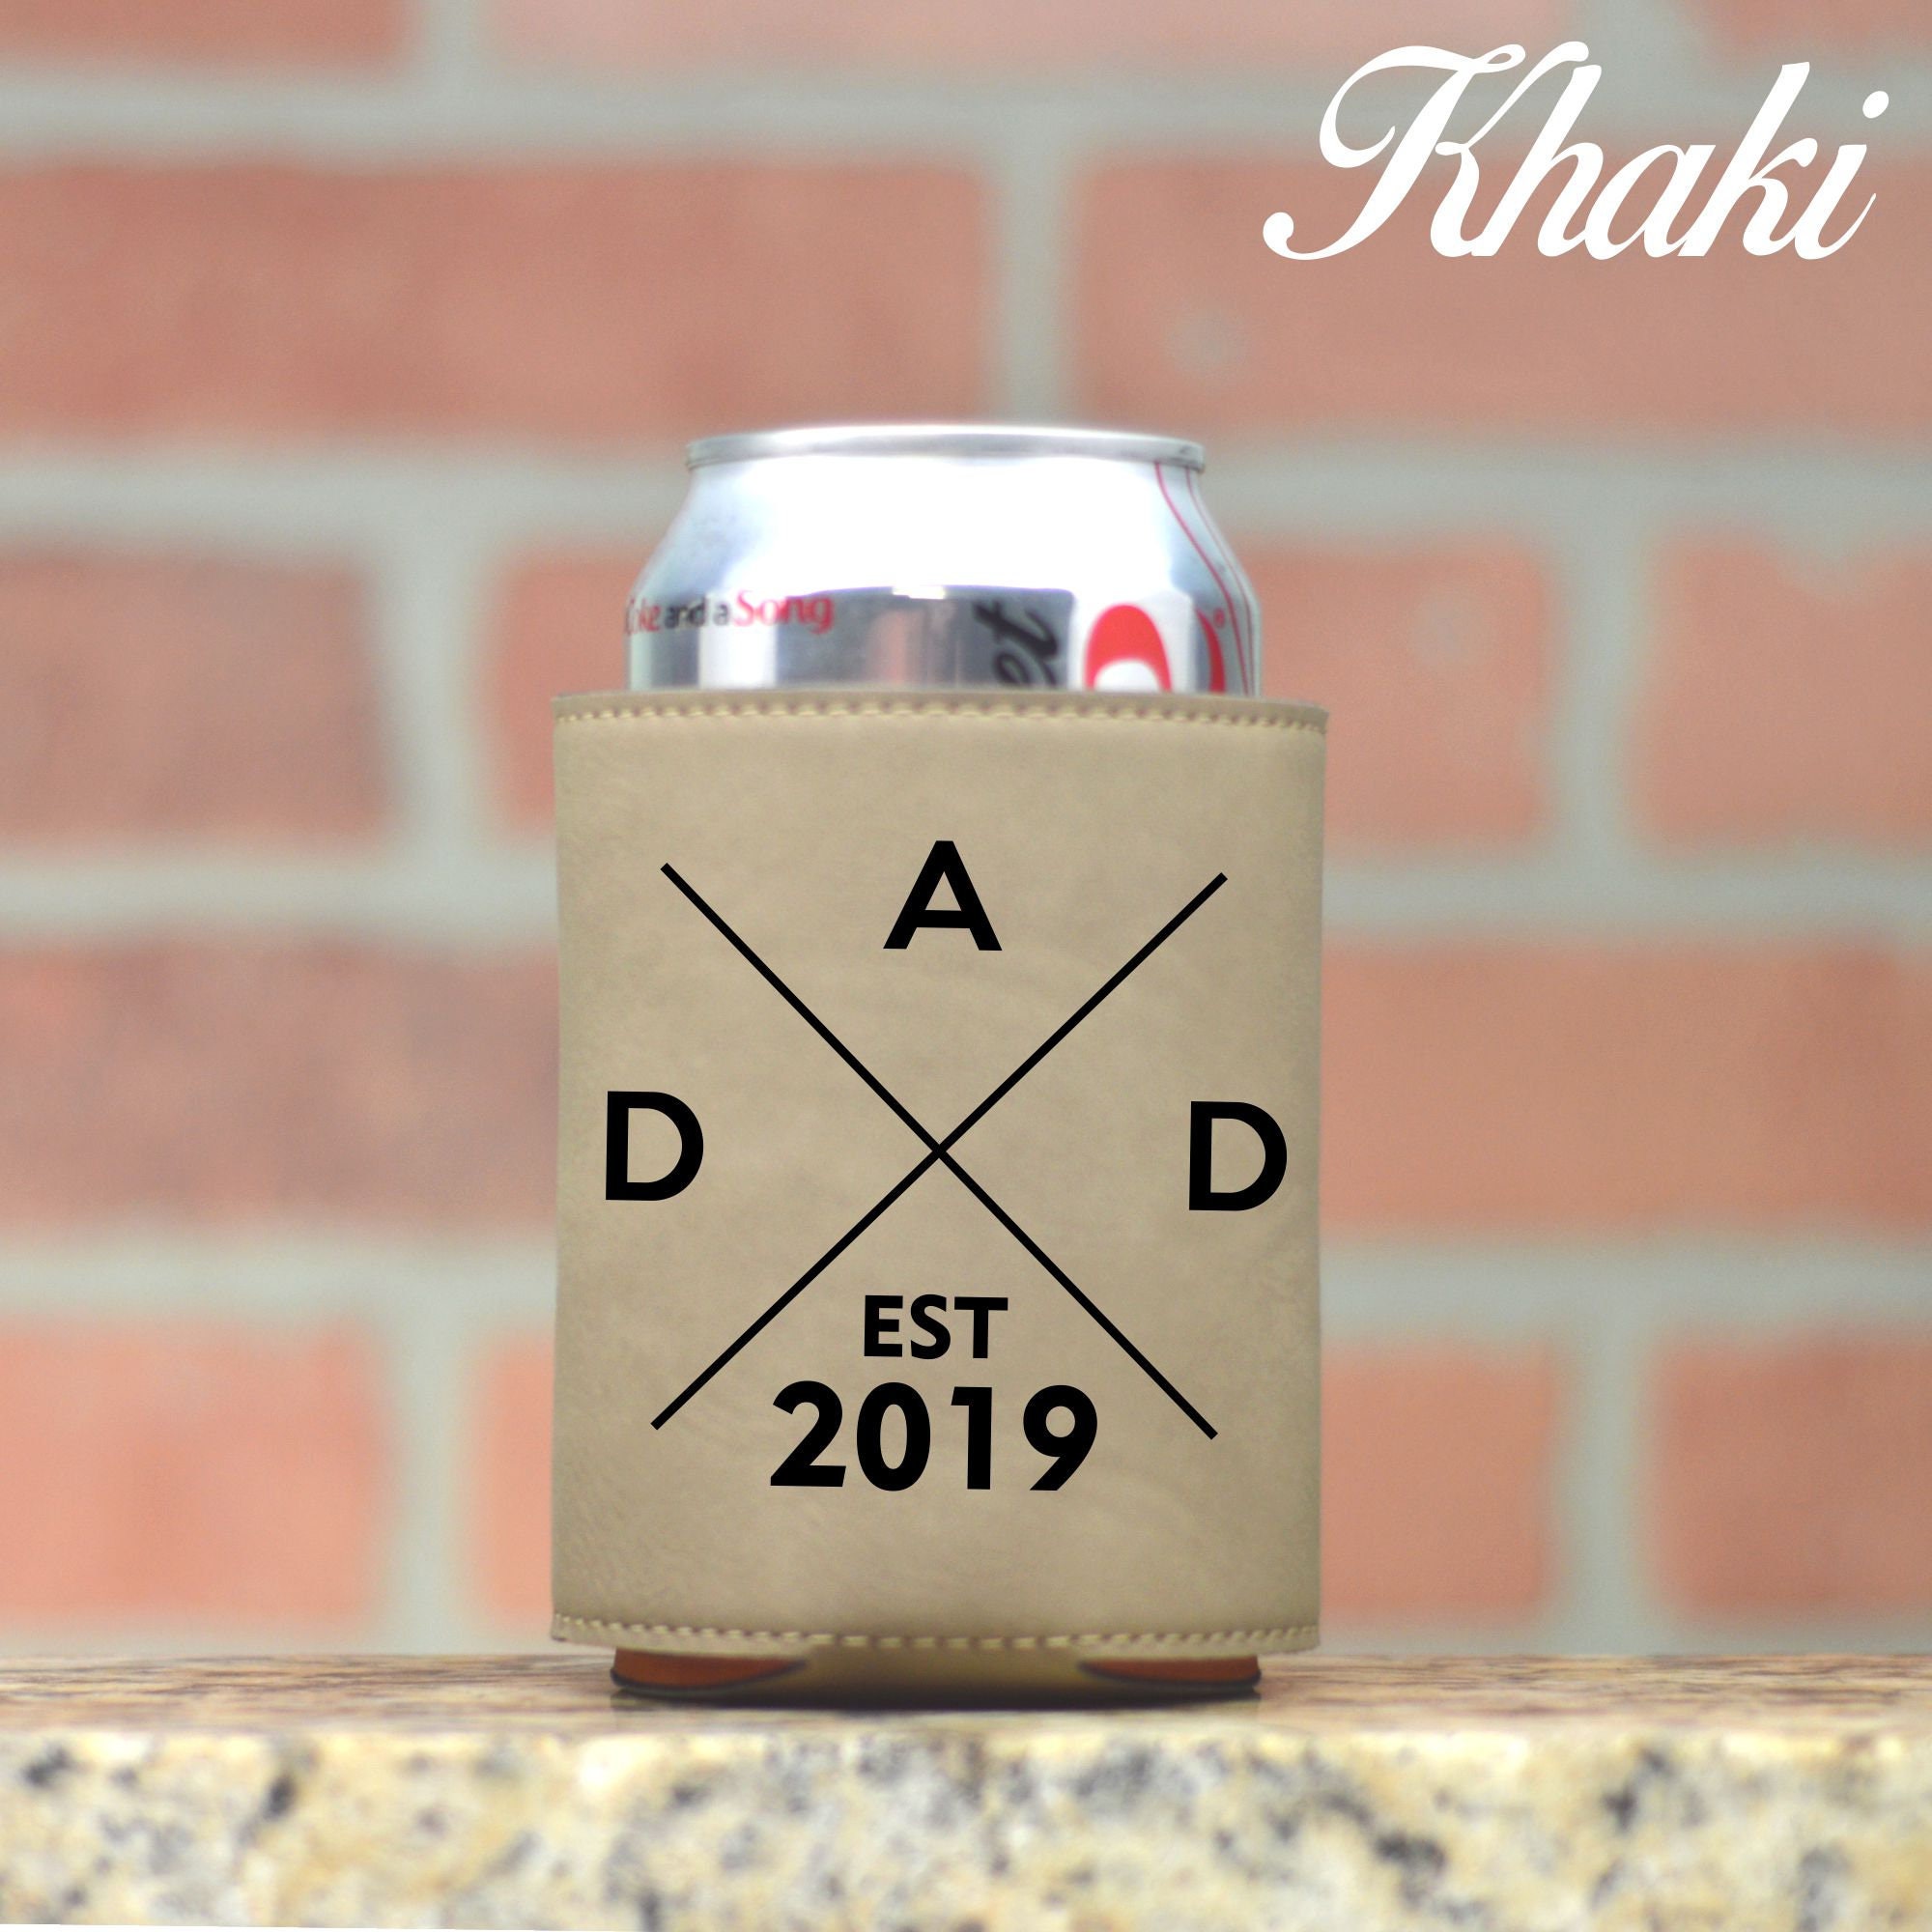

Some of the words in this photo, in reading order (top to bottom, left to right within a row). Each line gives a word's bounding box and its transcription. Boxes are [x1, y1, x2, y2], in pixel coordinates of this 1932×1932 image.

[664, 595, 707, 629] and
[713, 603, 732, 627] a
[734, 590, 836, 637] Song
[884, 840, 1002, 952] A
[606, 1092, 704, 1202] D
[1189, 1101, 1288, 1211] D
[865, 1294, 1009, 1359] EST
[771, 1381, 1098, 1492] 2019
